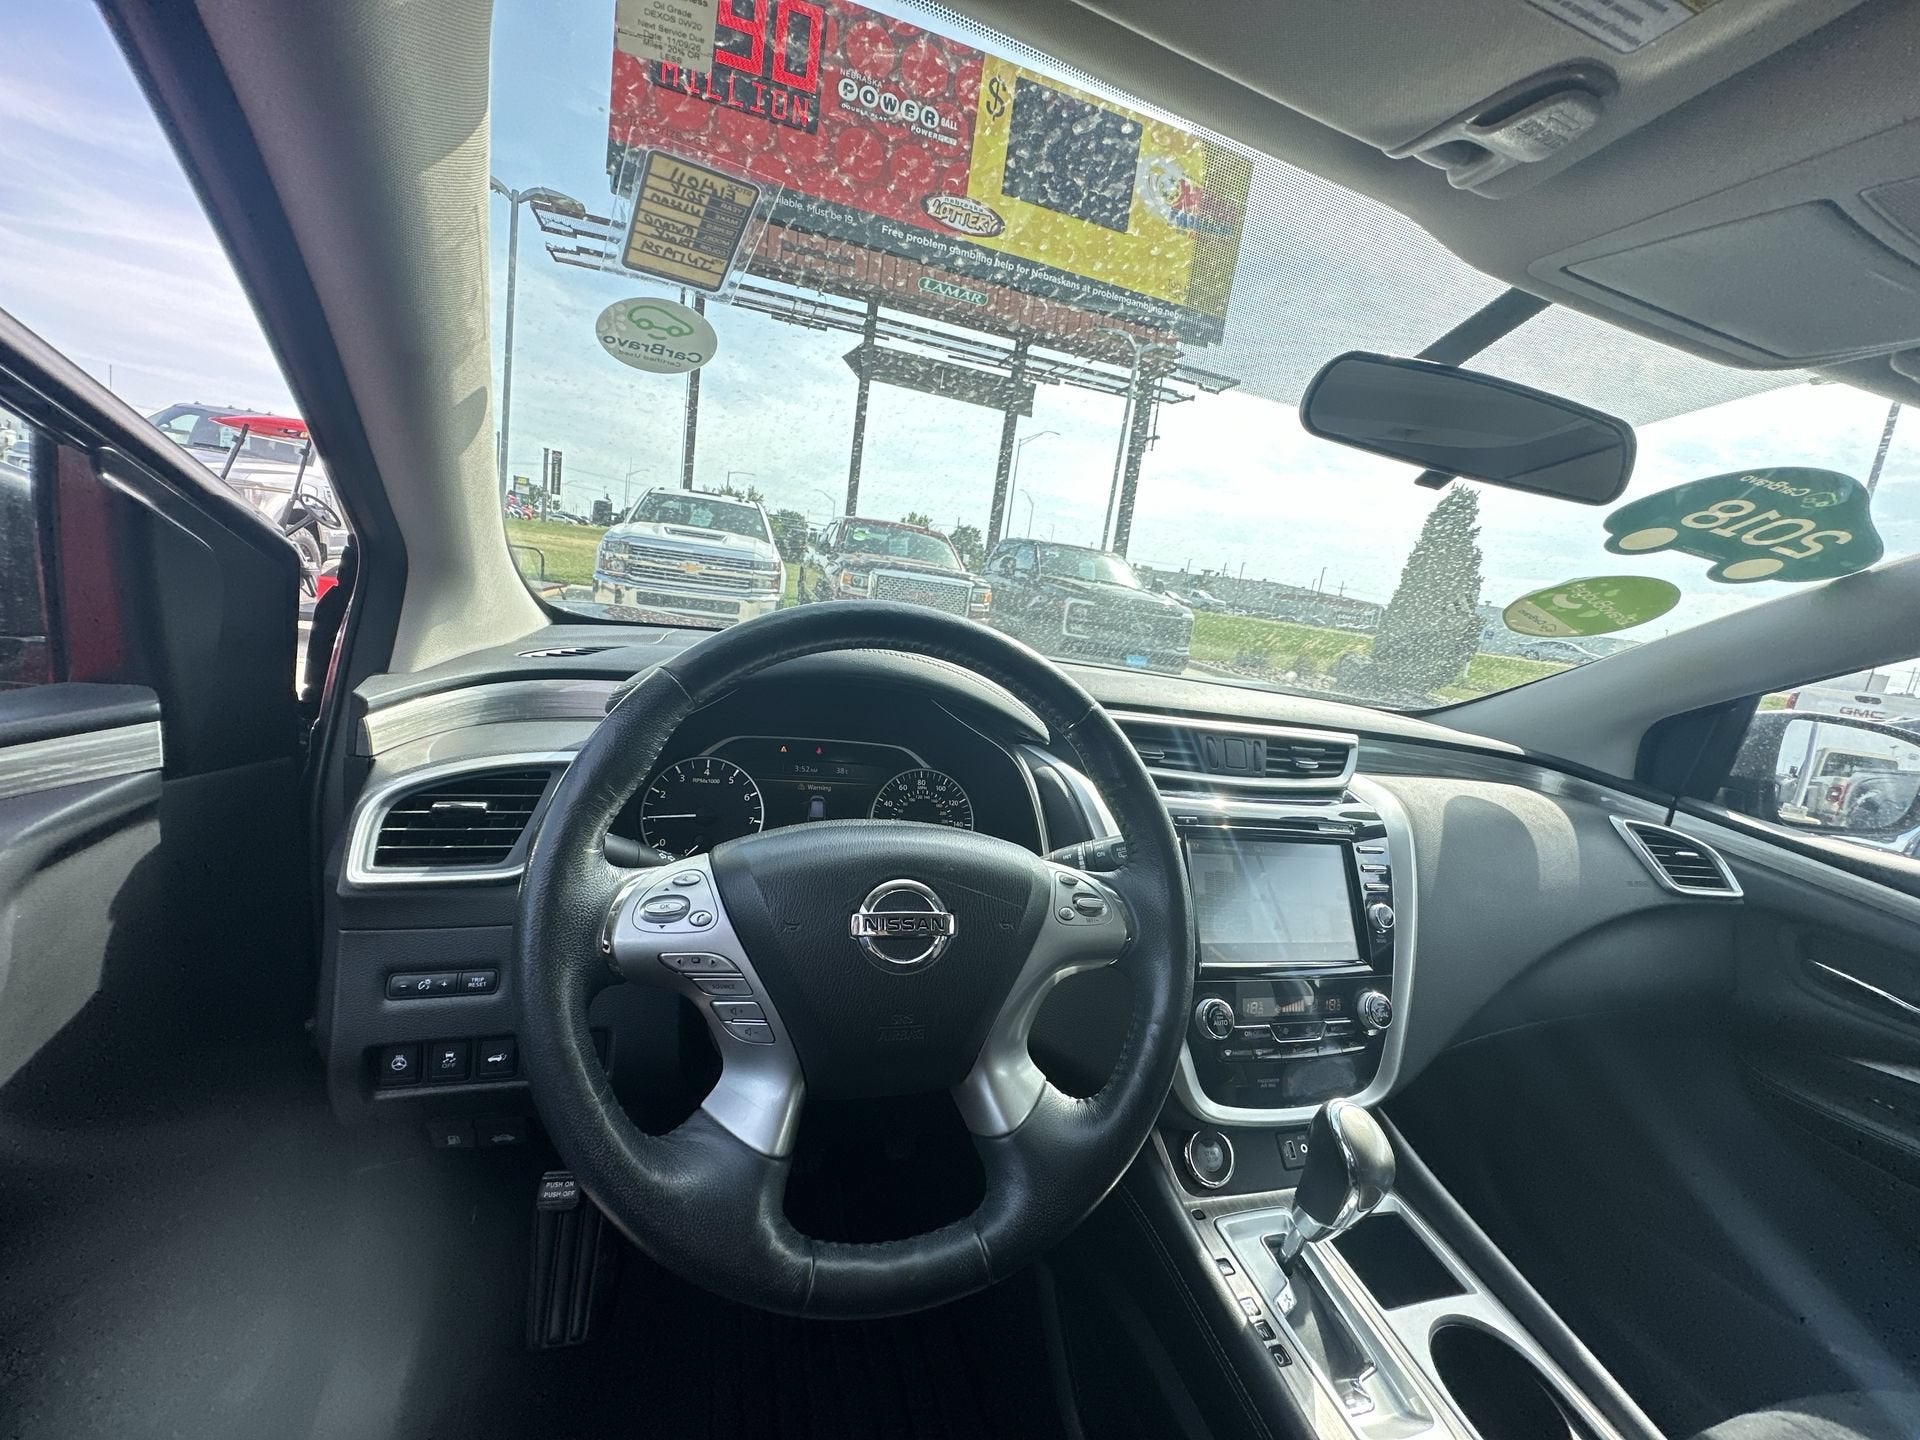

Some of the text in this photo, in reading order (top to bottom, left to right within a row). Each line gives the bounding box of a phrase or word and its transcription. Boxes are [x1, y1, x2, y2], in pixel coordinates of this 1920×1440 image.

[653, 1, 665, 11] Oil
[667, 5, 692, 18] Grade
[644, 8, 676, 23] DEXOS
[637, 19, 705, 43] Next Service Due
[643, 30, 662, 41] Date
[660, 54, 682, 64] LESS
[840, 68, 883, 88] NEBRASKA
[661, 62, 809, 128] MILLION
[831, 210, 843, 222] be
[928, 199, 998, 233] LOTTERY
[881, 225, 904, 239] Free
[906, 233, 947, 252] problem
[949, 246, 993, 266] gambling
[994, 256, 1015, 272] help
[1016, 264, 1029, 274] for
[1031, 268, 1081, 290] Nebraskans
[1082, 284, 1091, 293] at
[923, 279, 982, 304] LAMAR
[1840, 706, 1886, 719] GMC
[703, 768, 710, 776] 4
[679, 774, 686, 783] 3
[728, 776, 734, 785] 5
[807, 784, 832, 793] Warning
[898, 784, 908, 792] 60
[660, 791, 666, 799] 2
[743, 793, 751, 802] 6
[883, 800, 893, 808] 40
[748, 817, 755, 825] 7
[659, 838, 666, 847] 0
[864, 917, 946, 932] NISSAN
[562, 1180, 574, 1188] ON
